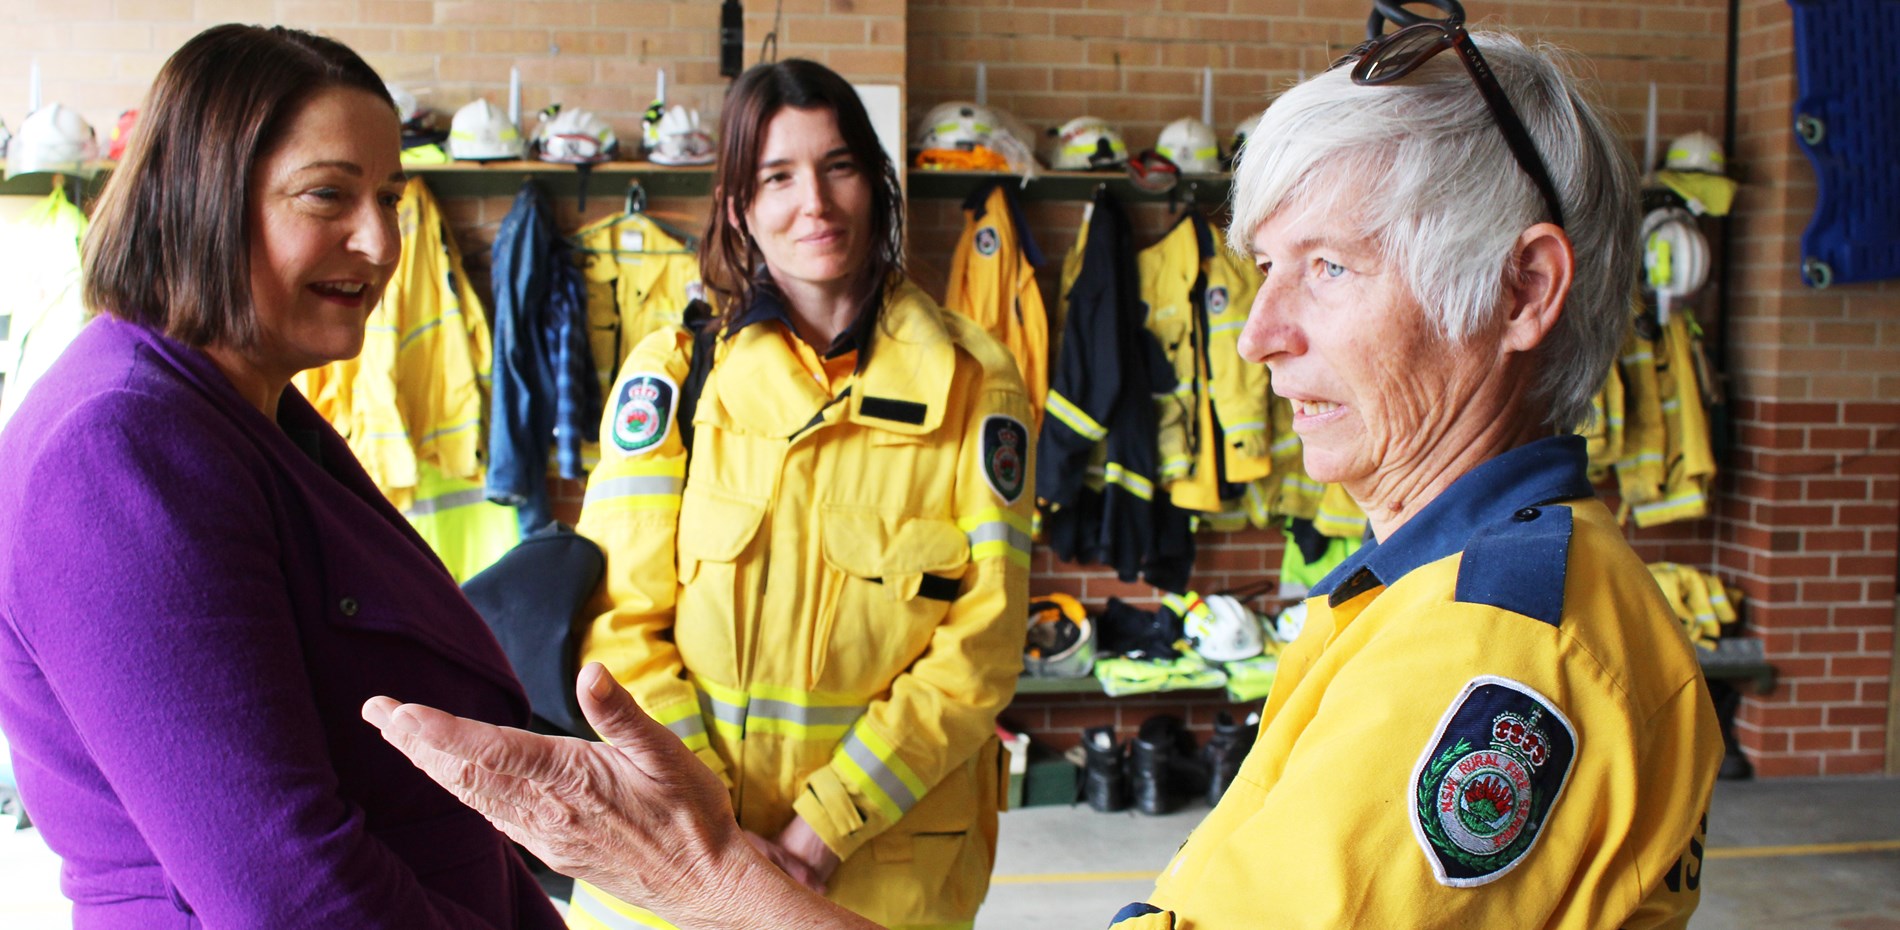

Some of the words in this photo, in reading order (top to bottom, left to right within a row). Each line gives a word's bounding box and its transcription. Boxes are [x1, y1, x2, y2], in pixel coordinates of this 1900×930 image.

[1459, 754, 1500, 775] RURAL
[1505, 761, 1530, 790] FIRE
[1441, 777, 1458, 813] NSW
[1493, 800, 1530, 848] SERVICE
